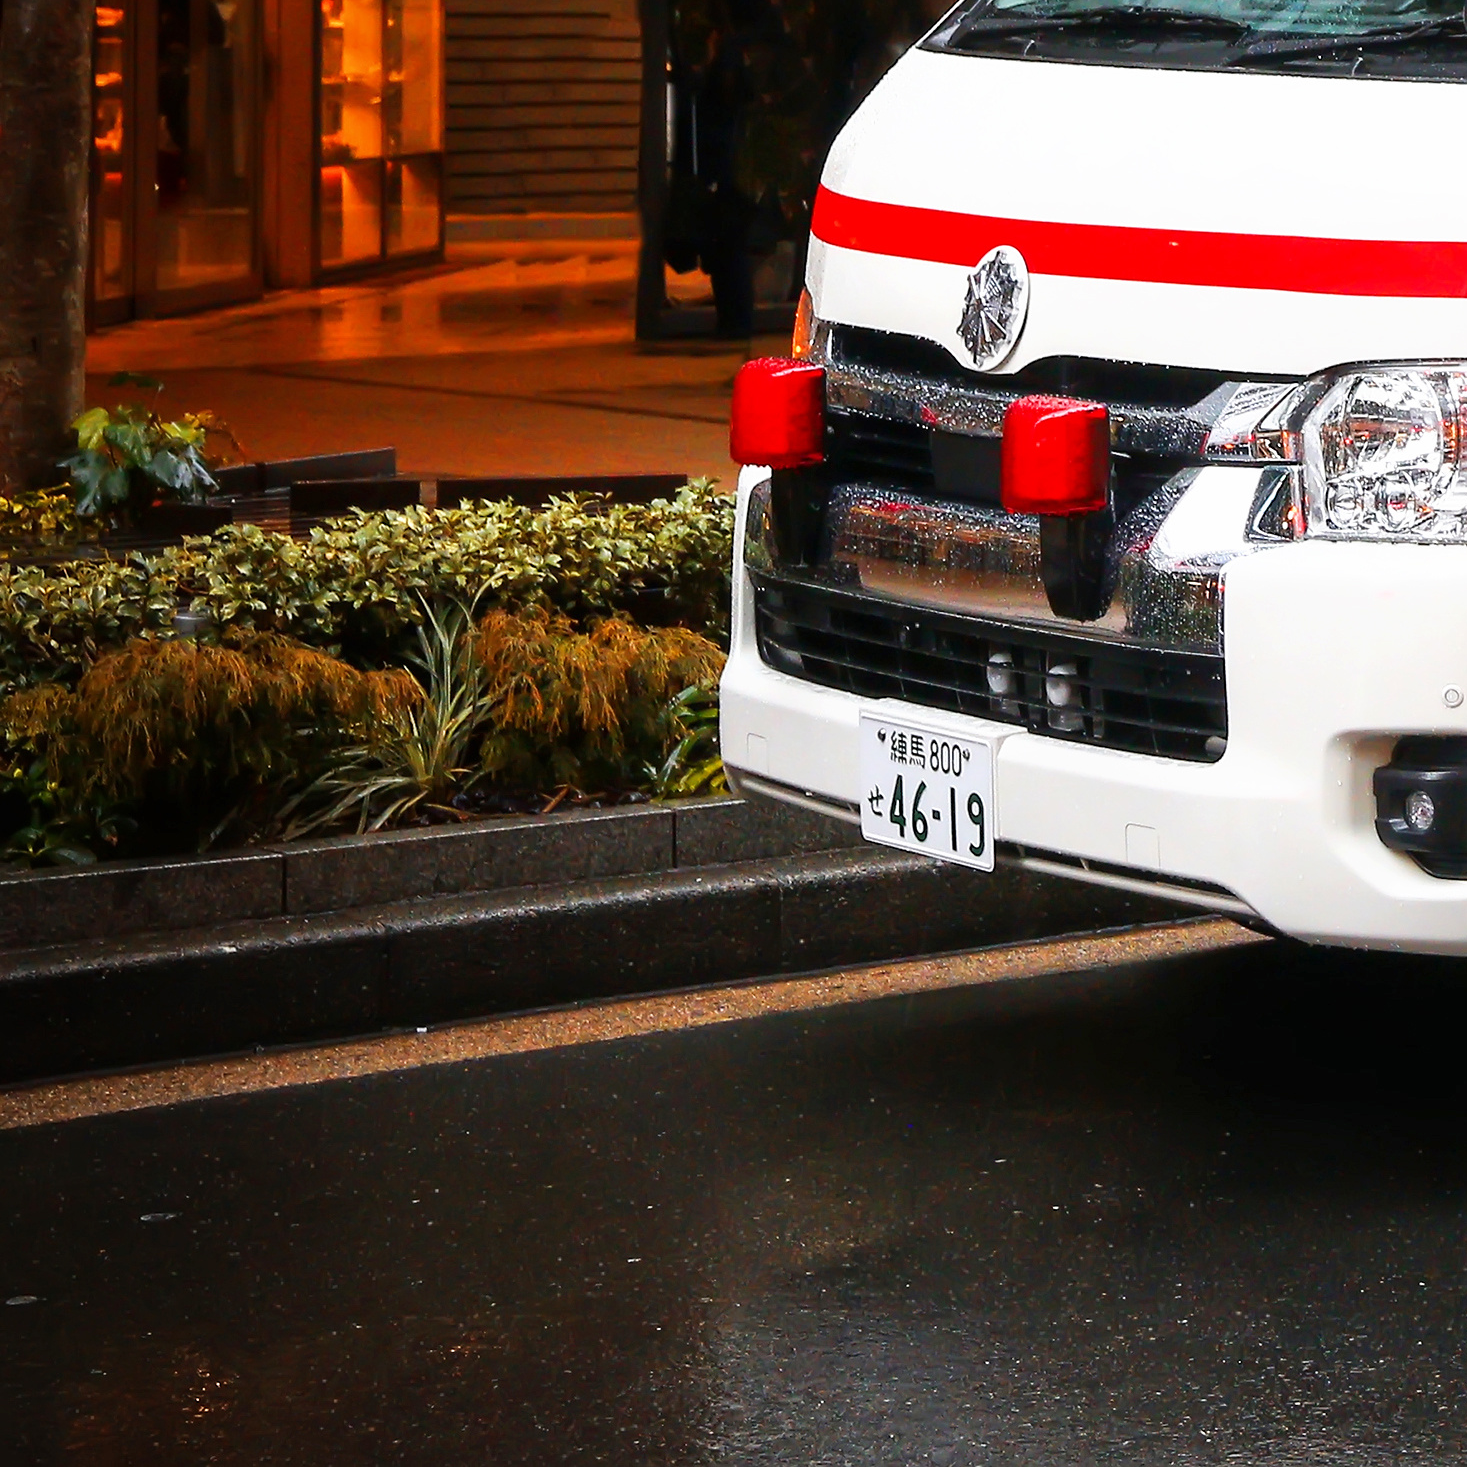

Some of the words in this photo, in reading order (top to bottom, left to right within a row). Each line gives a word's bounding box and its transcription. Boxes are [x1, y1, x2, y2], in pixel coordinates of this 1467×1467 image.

[890, 730, 926, 769] 練馬
[929, 739, 962, 777] 800
[867, 784, 884, 817] せ
[889, 773, 985, 858] 46-19
